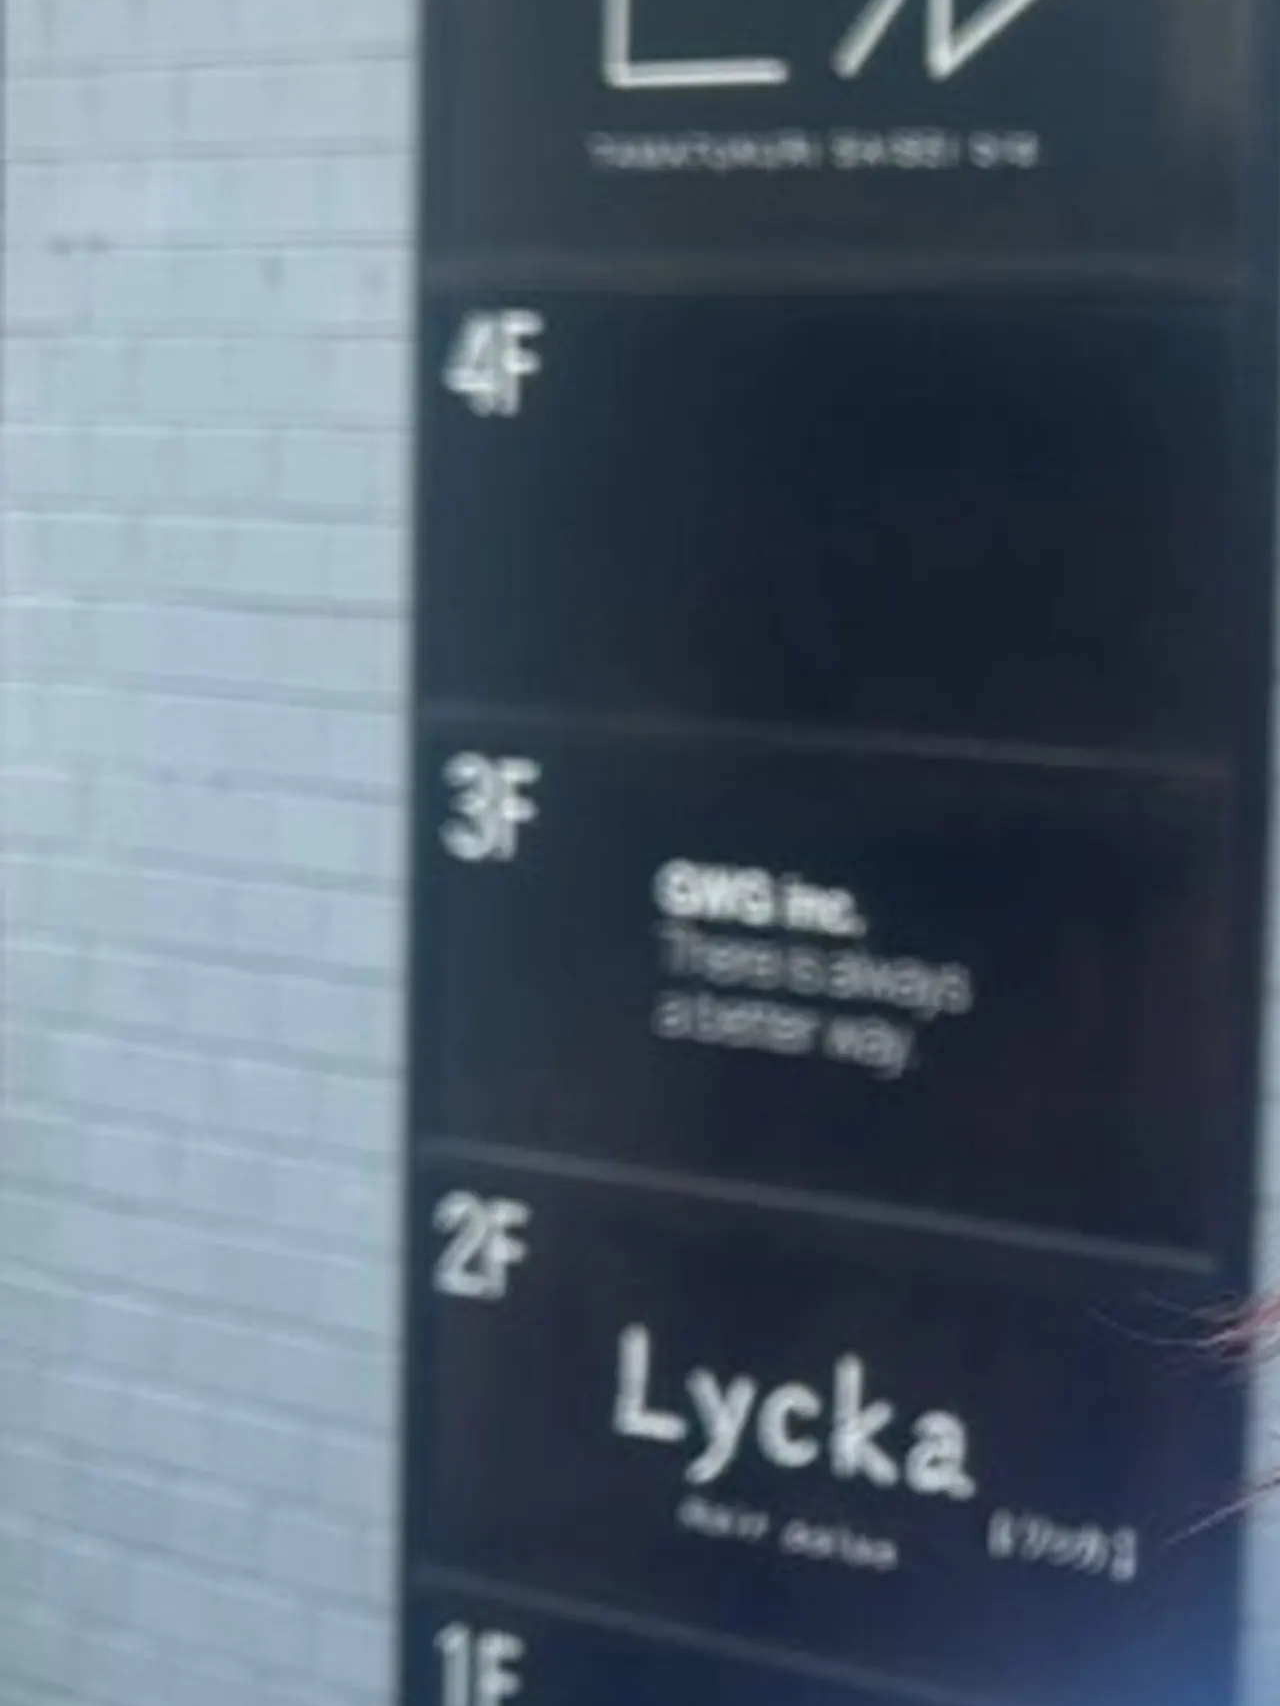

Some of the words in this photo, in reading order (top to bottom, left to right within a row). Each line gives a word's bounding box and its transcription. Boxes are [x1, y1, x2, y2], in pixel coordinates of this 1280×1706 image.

[444, 309, 545, 416] 4F
[440, 752, 541, 860] 3F
[653, 993, 692, 1038] a
[694, 993, 822, 1054] better
[656, 922, 783, 988] There
[828, 951, 975, 1021] always
[433, 1190, 533, 1300] 2F
[614, 1323, 976, 1501] Lycka
